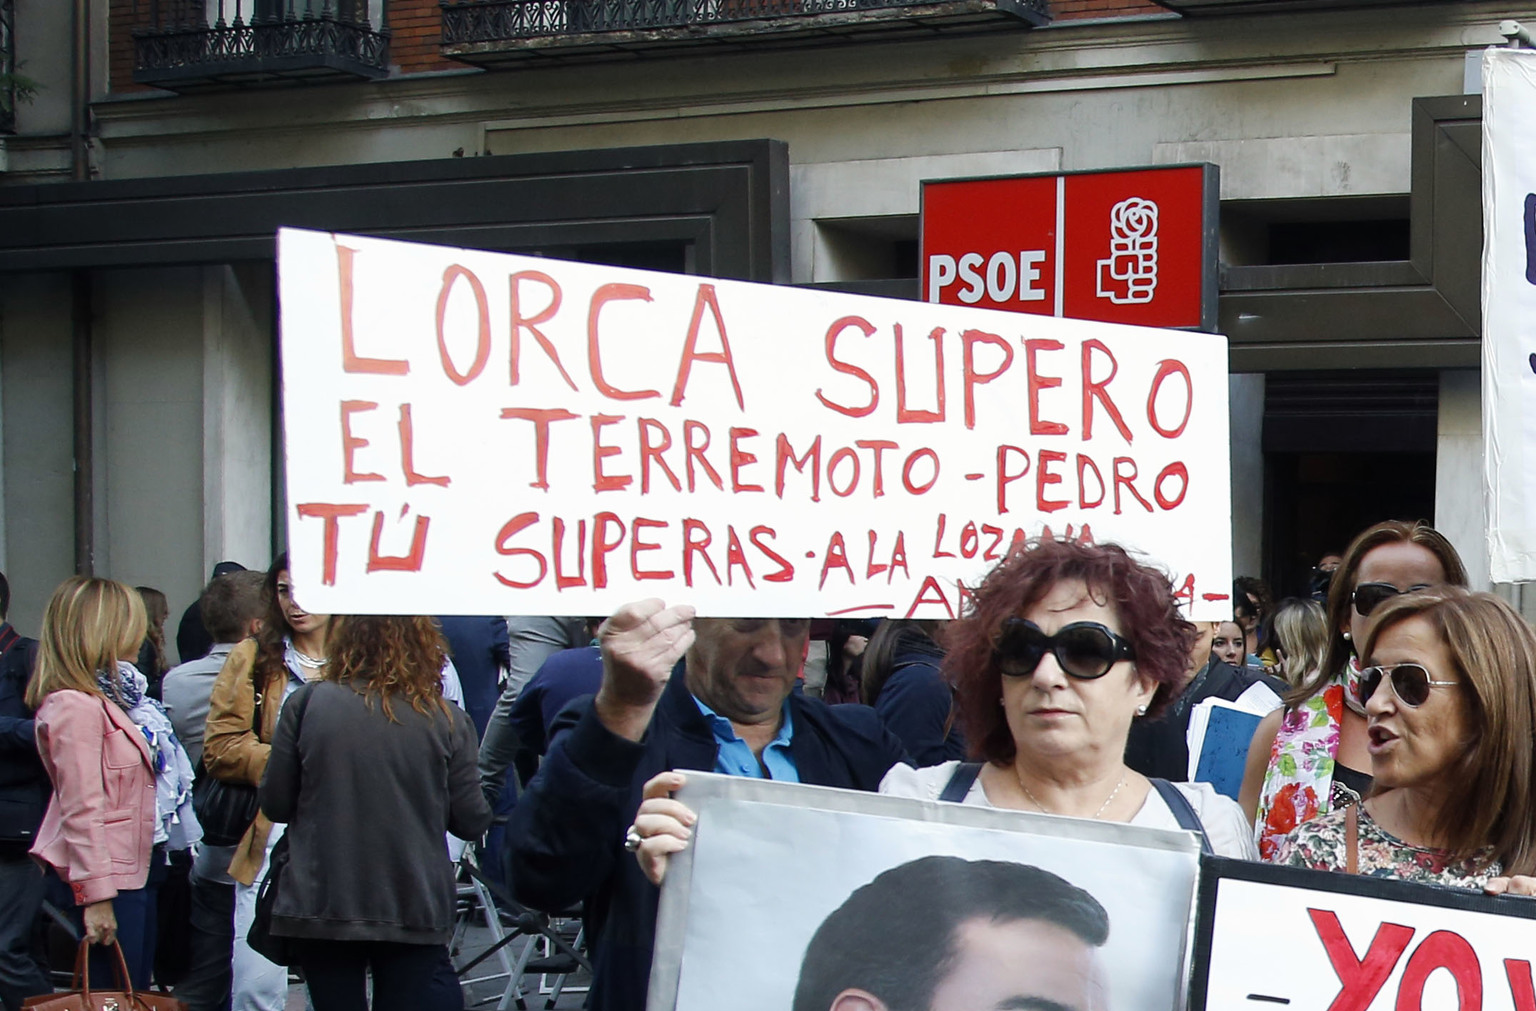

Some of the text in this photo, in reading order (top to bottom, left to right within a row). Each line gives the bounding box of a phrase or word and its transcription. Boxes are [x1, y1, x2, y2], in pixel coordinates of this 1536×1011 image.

[928, 250, 1046, 304] PSOE
[334, 244, 1194, 446] LORCA SUPERO
[340, 400, 452, 489] EL
